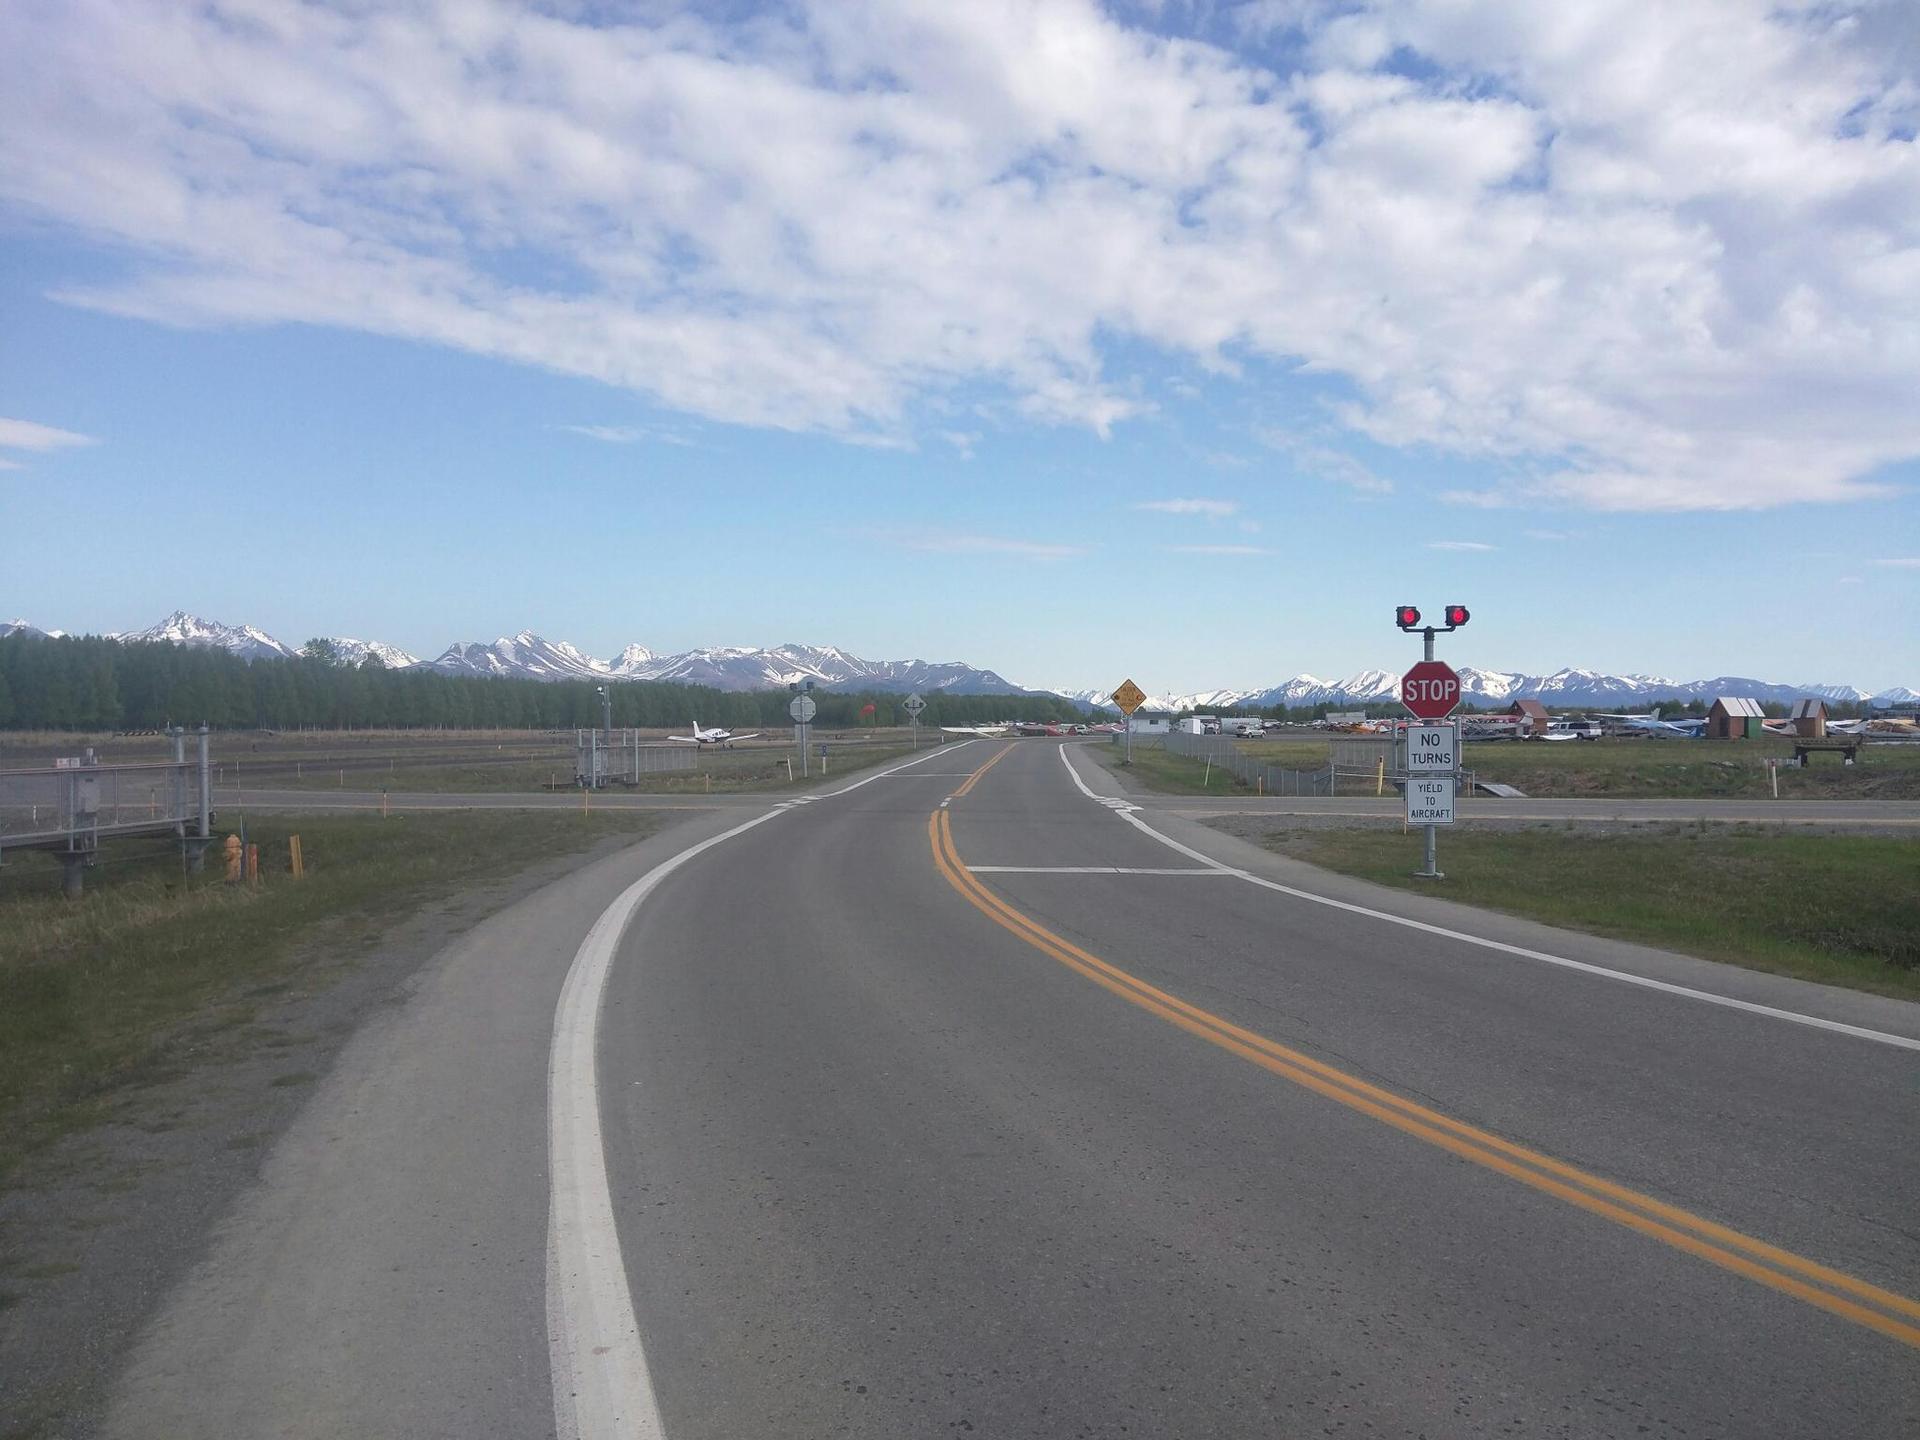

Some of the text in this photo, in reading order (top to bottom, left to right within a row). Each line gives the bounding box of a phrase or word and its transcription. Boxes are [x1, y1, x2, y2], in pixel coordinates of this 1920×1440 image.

[1406, 680, 1457, 701] STOP
[1421, 733, 1440, 746] NO
[1412, 753, 1451, 764] TURNS
[1418, 784, 1443, 793] YIELD
[1426, 796, 1436, 806] TO
[1411, 810, 1451, 818] AIRCRAFT
